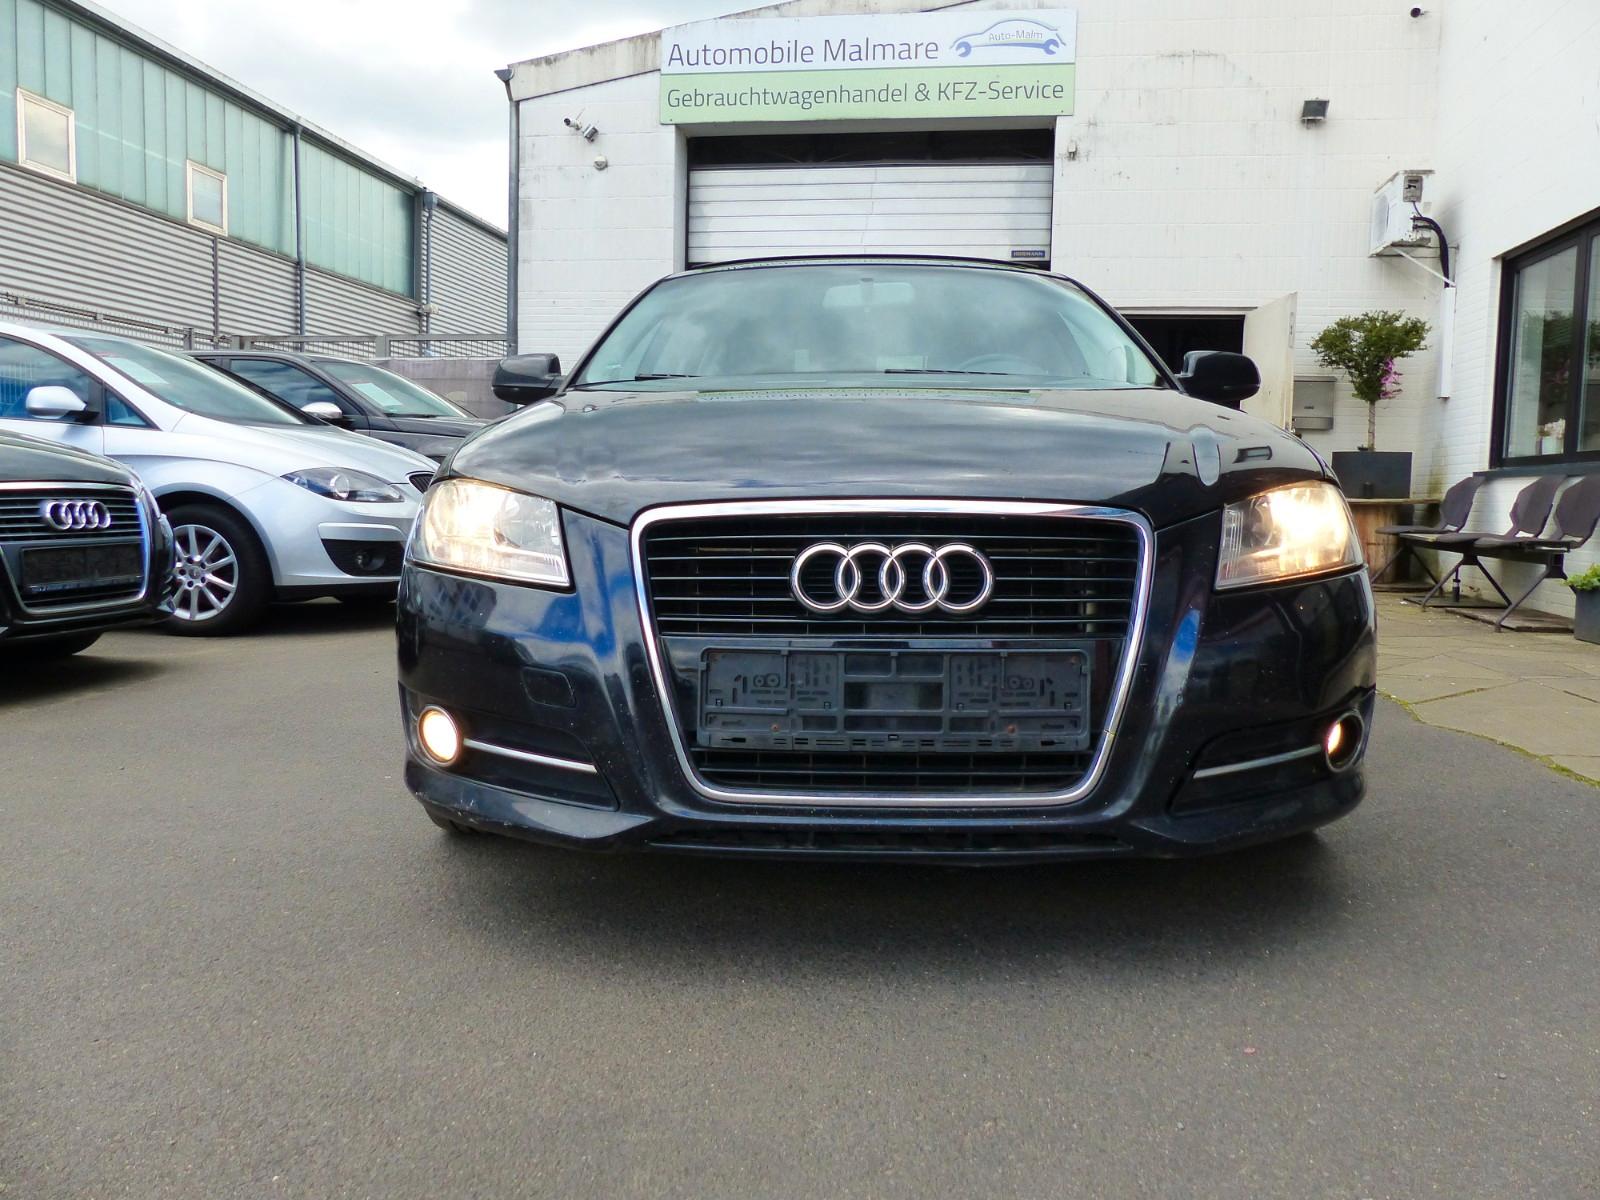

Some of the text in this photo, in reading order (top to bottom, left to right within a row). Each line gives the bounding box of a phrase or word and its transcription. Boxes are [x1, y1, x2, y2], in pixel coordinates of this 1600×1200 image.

[988, 29, 1043, 41] Auto-Malm
[668, 37, 939, 67] Automobile Malmare
[667, 80, 1064, 110] Gebrauchtwagenhandel & KFZ-Service
